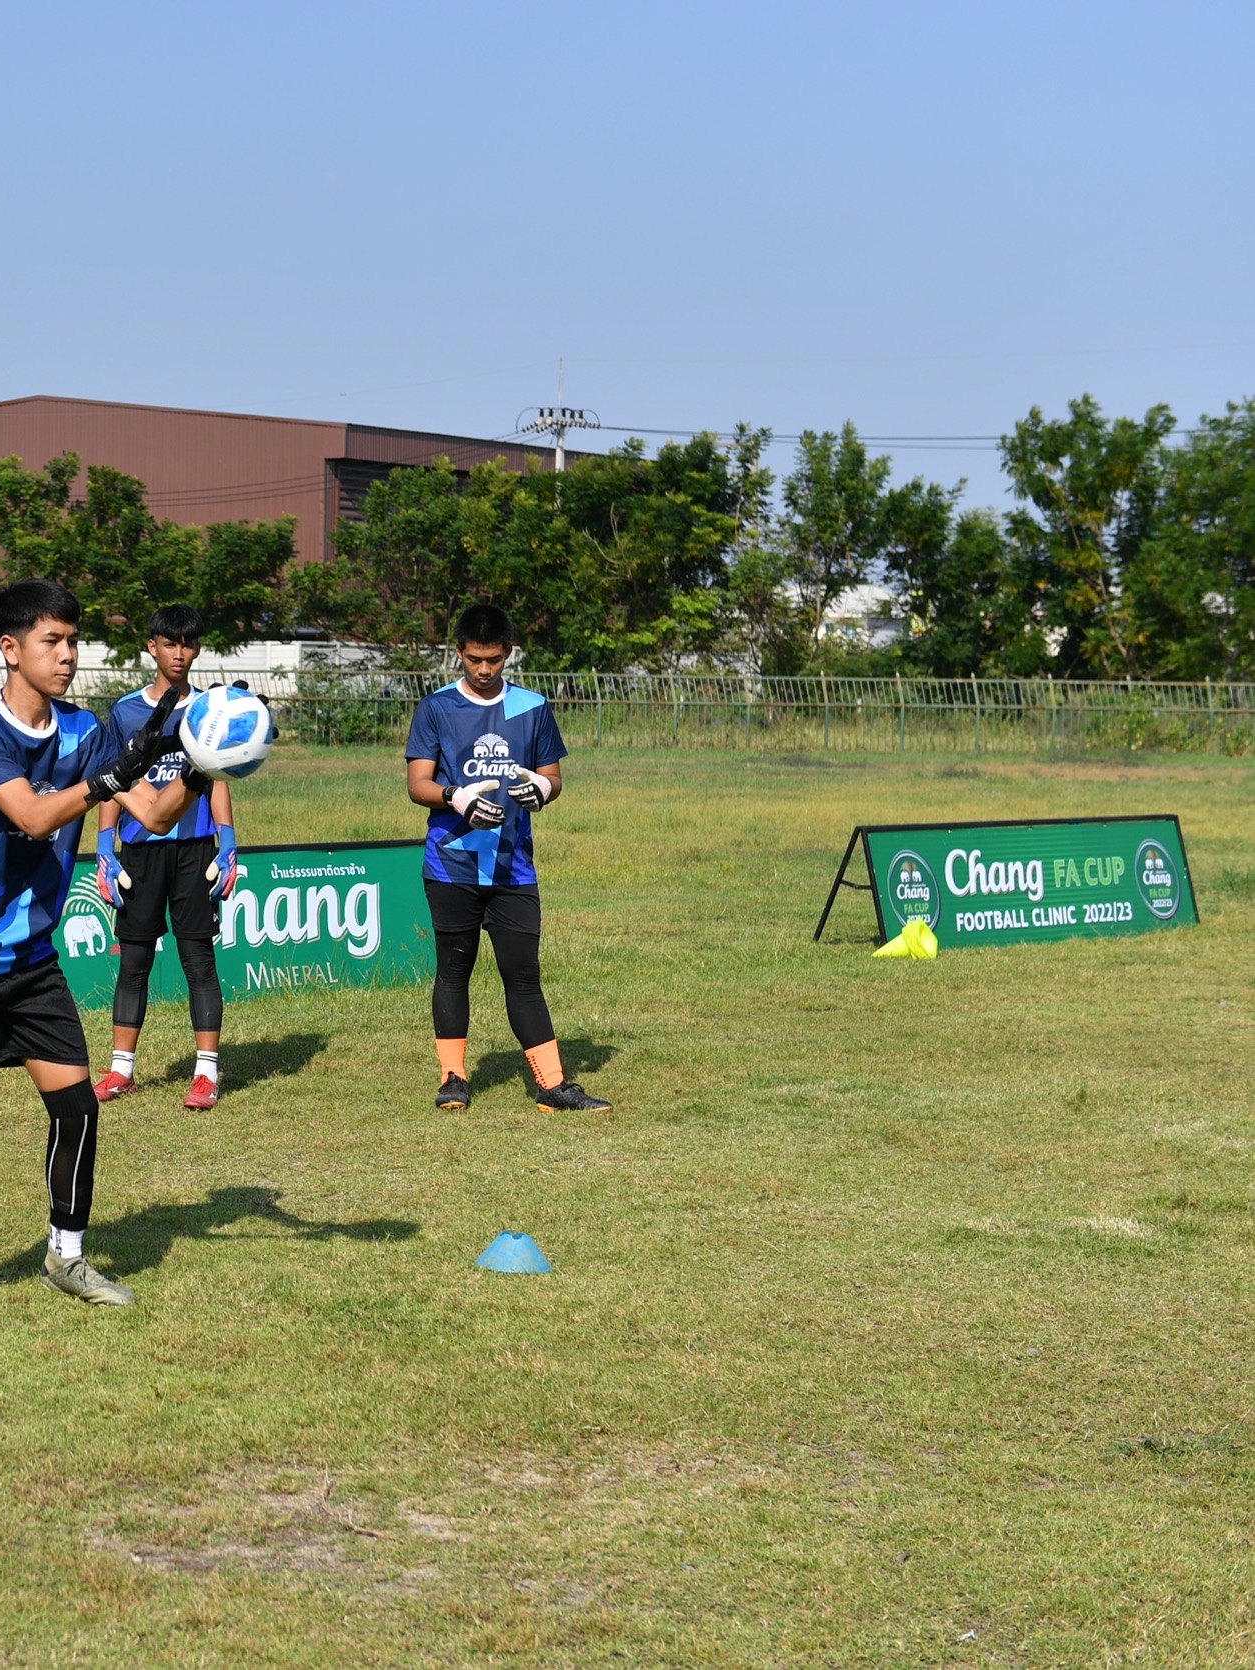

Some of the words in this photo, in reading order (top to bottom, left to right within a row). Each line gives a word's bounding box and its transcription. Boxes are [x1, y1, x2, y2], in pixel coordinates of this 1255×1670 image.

[205, 710, 224, 746] molten
[945, 849, 1045, 903] Chang
[1053, 859, 1081, 888] FA
[1084, 856, 1125, 886] CUP
[1142, 870, 1171, 887] Chang
[896, 883, 930, 901] Chang
[211, 865, 382, 959] hang
[903, 904, 914, 914] FA
[914, 903, 930, 913] CUP
[956, 908, 1029, 932] FOOTBALL
[1032, 906, 1077, 927] CLINIC
[1082, 902, 1133, 924] 2022/23
